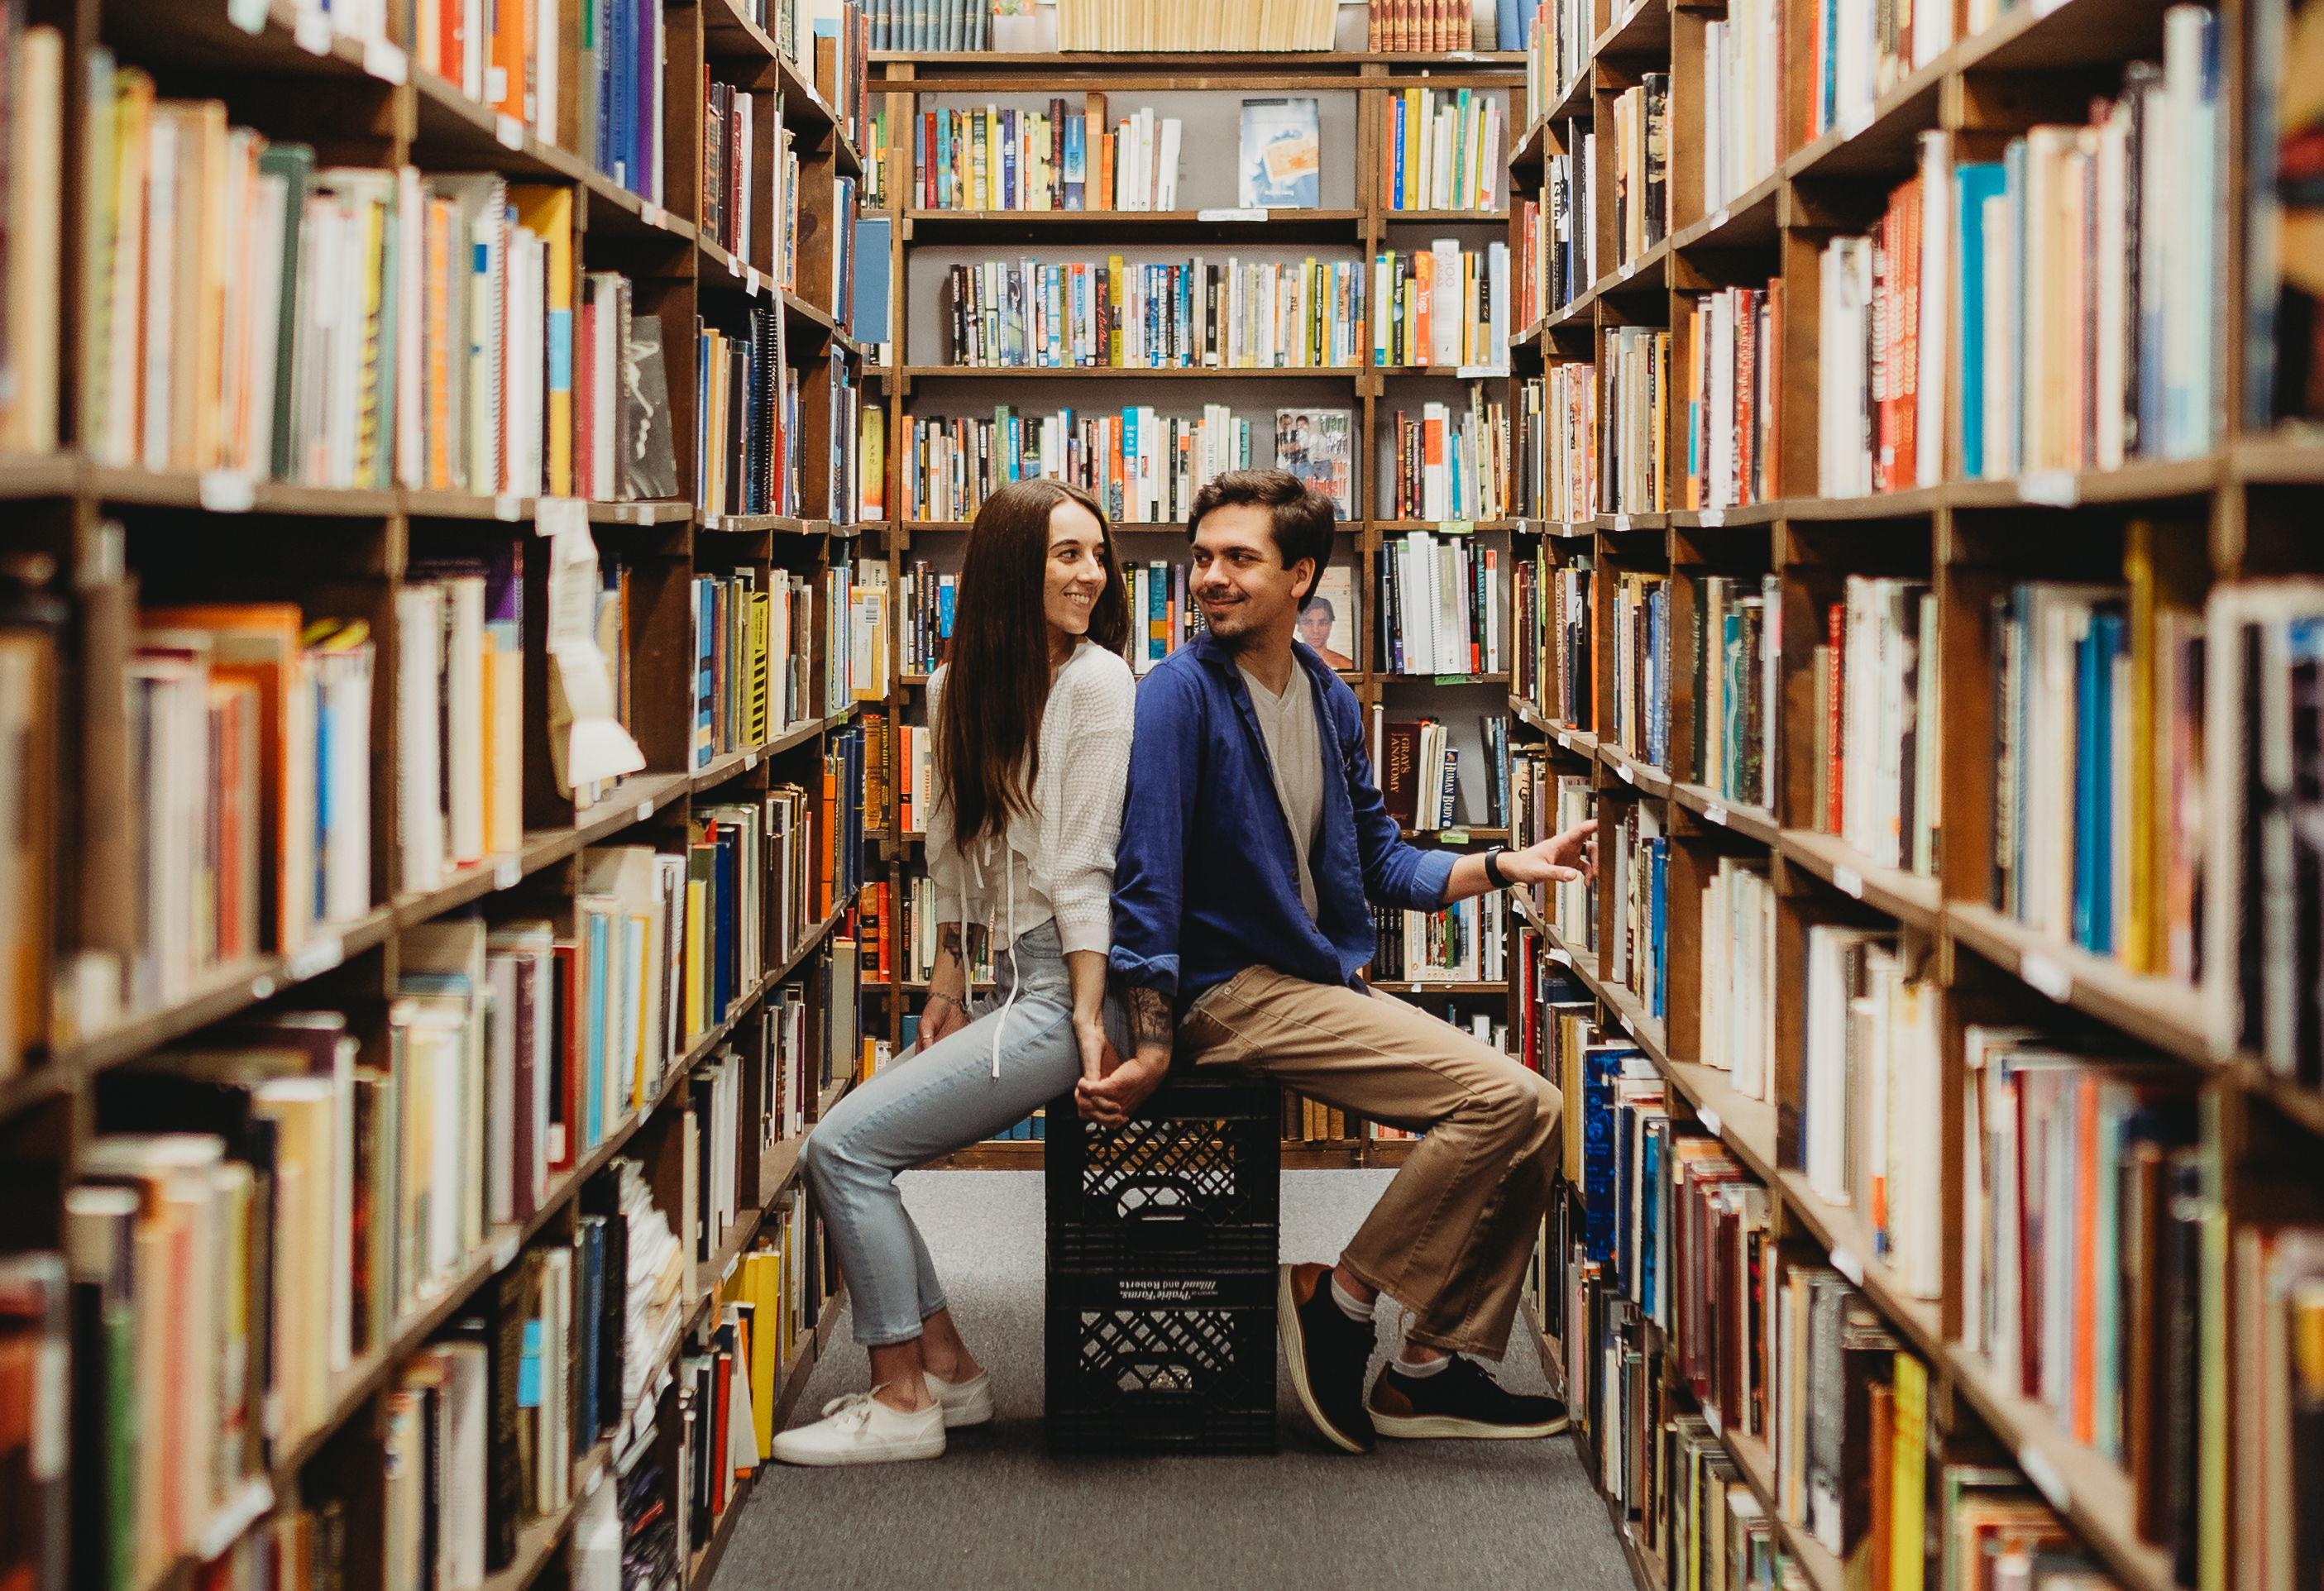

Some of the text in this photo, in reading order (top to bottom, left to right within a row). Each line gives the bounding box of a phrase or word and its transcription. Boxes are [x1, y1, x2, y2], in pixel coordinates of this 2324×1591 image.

[974, 121, 986, 137] THE
[974, 178, 986, 199] KING
[1394, 288, 1404, 303] Yoga
[1417, 291, 1429, 313] Yoga
[1319, 413, 1348, 432] Every
[1332, 457, 1347, 475] for
[1306, 476, 1347, 497] Himself
[1477, 564, 1485, 605] MASSAGE
[1390, 738, 1400, 793] ANATOMY
[1400, 738, 1412, 774] GRAY'S
[1442, 762, 1456, 820] HUMAN BODY
[1119, 1280, 1217, 1290] Hiland and Roberts
[1157, 1290, 1191, 1302] Prairie
